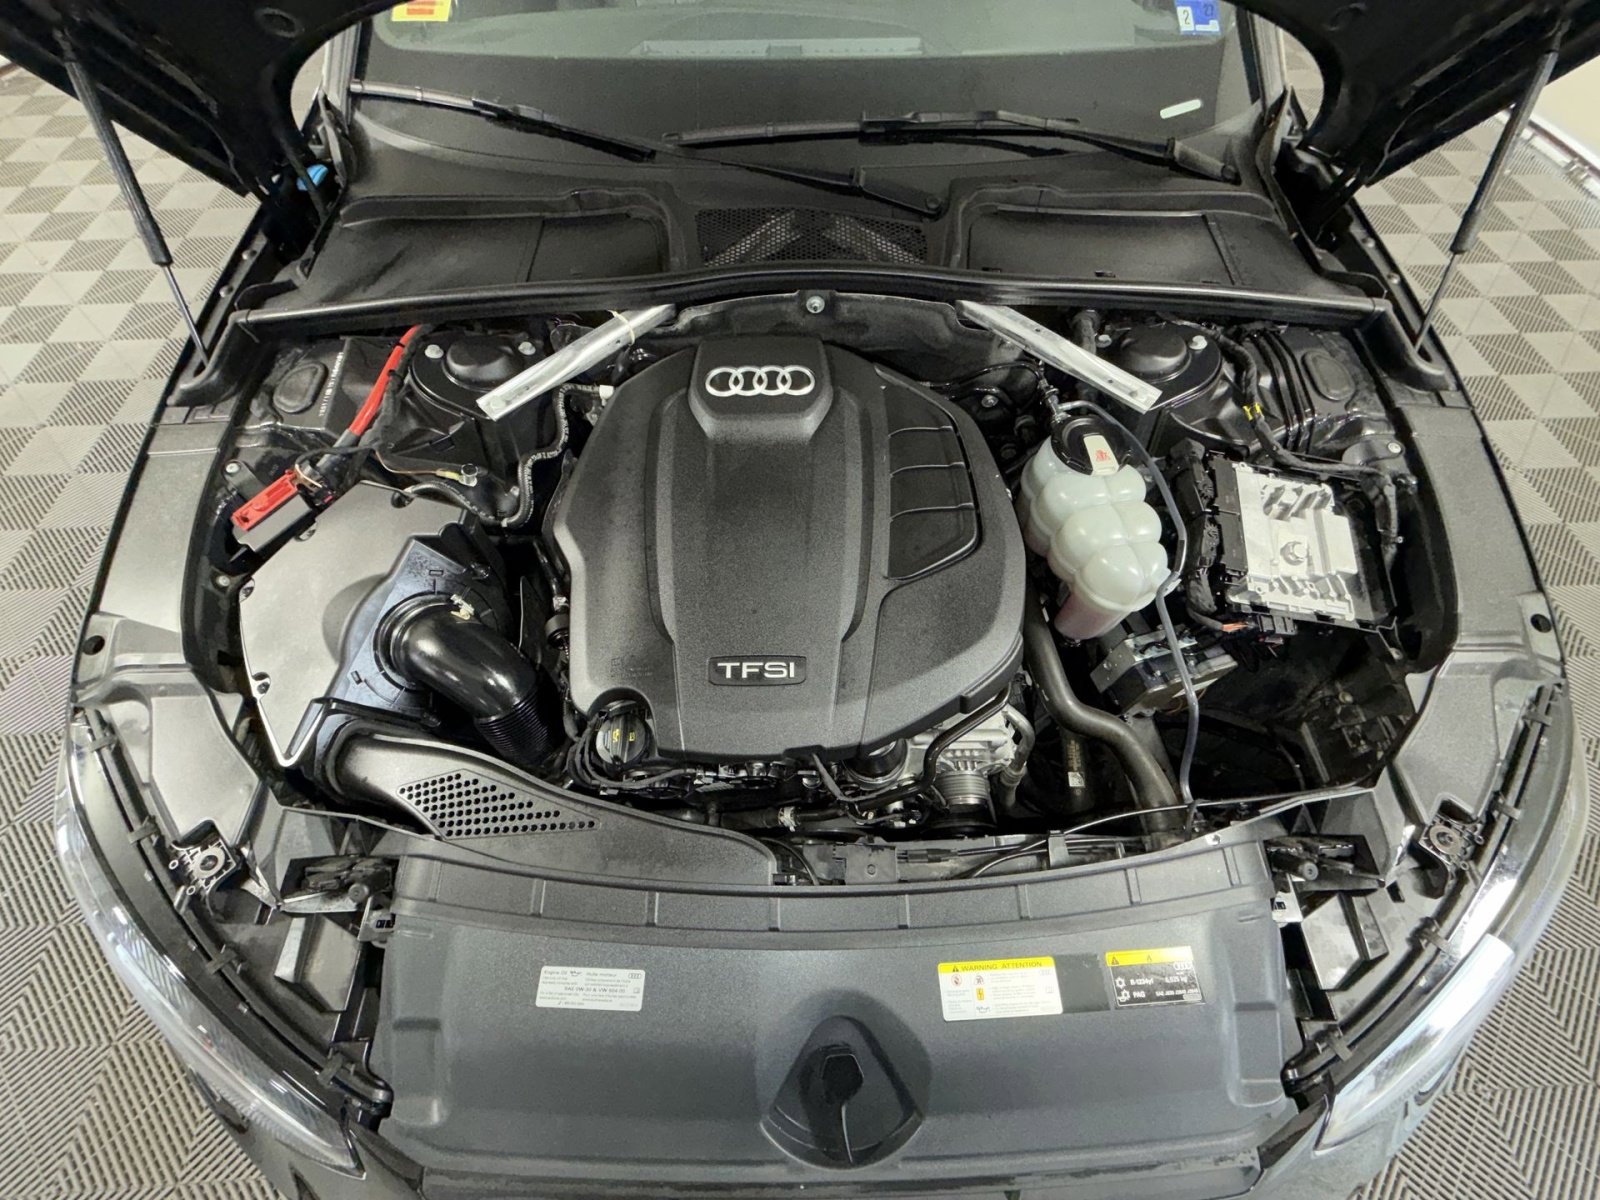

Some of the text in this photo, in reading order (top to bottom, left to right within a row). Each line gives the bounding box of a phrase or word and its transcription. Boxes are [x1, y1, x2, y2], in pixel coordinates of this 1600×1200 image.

[1183, 9, 1190, 25] 2
[717, 661, 795, 679] TFSI
[960, 961, 1043, 972] WARNING ATTENTION
